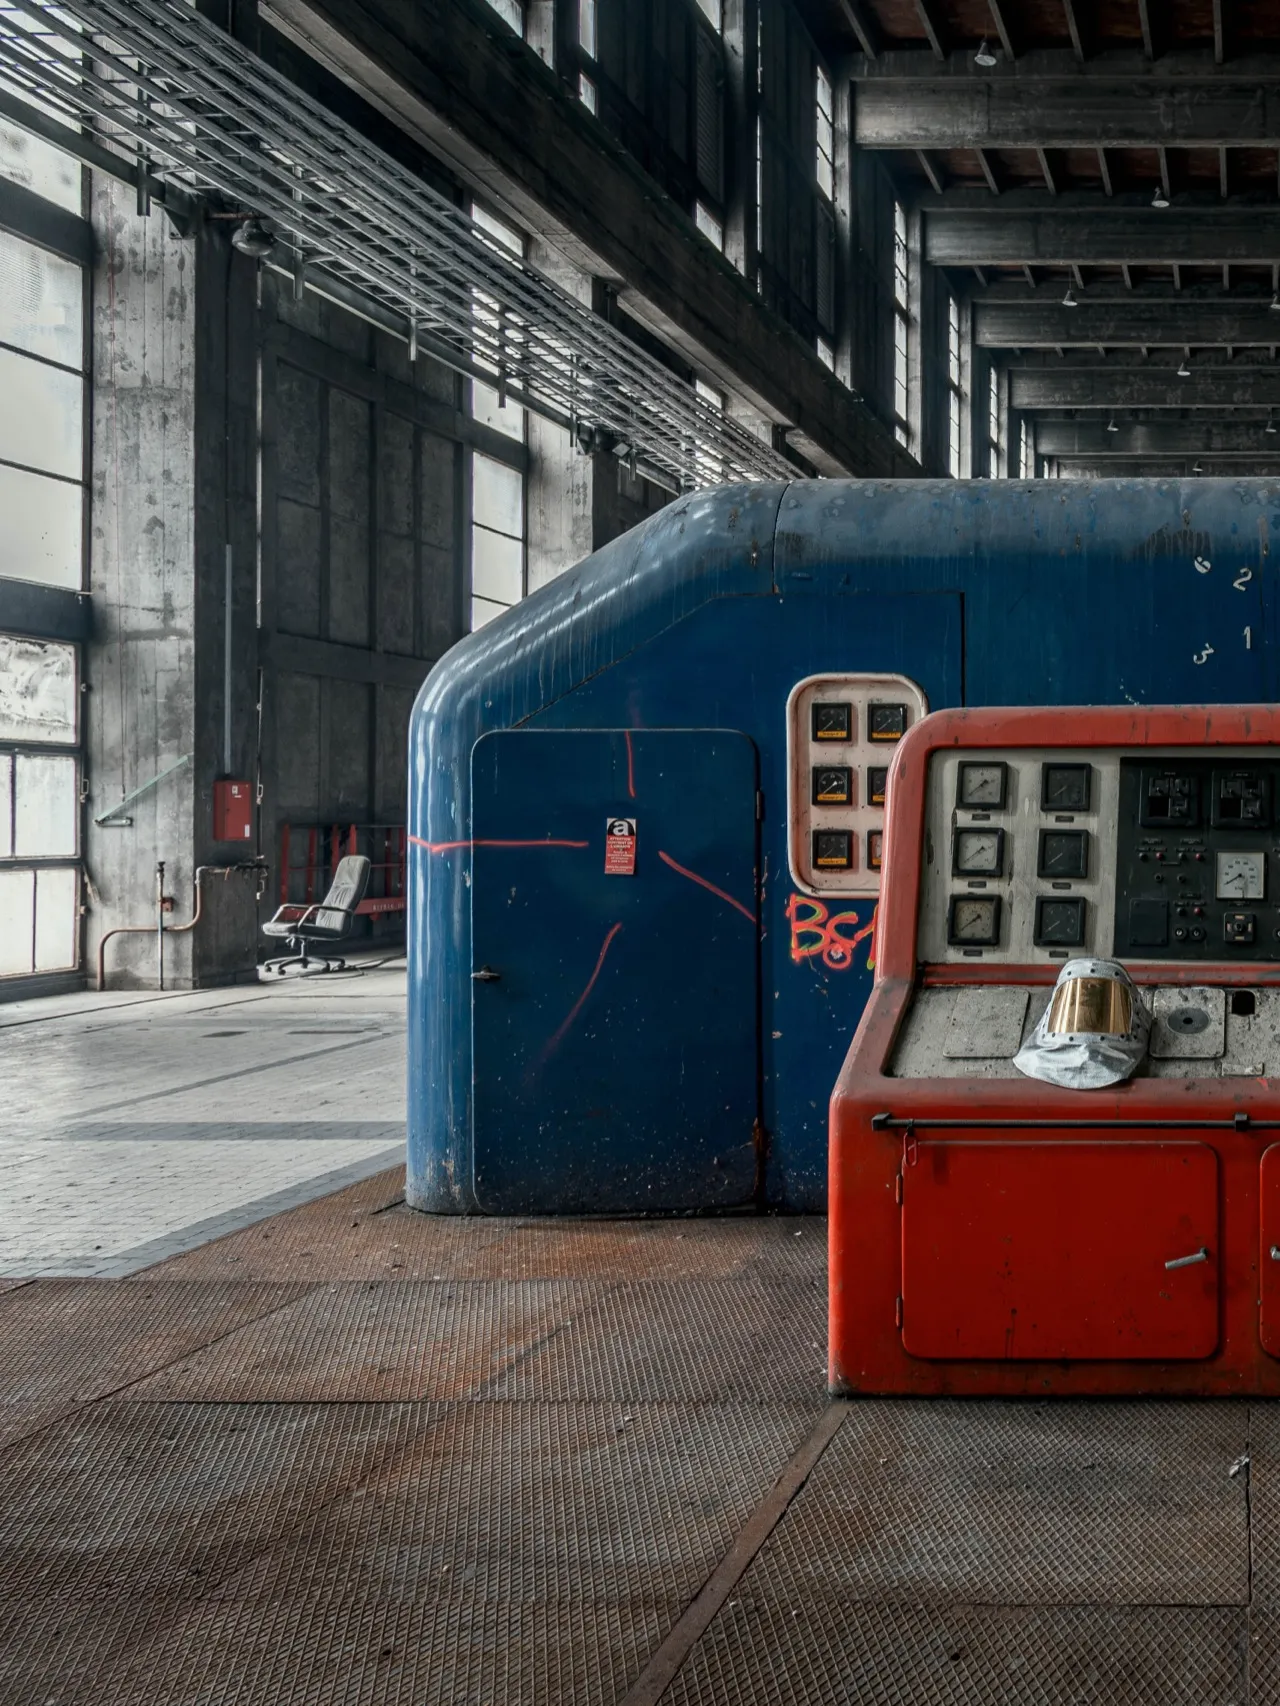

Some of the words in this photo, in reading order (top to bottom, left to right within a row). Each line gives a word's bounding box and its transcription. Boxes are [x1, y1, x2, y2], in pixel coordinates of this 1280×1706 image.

[1232, 567, 1253, 592] 2
[1242, 625, 1252, 650] 1
[1193, 642, 1215, 665] 3
[612, 820, 629, 836] a
